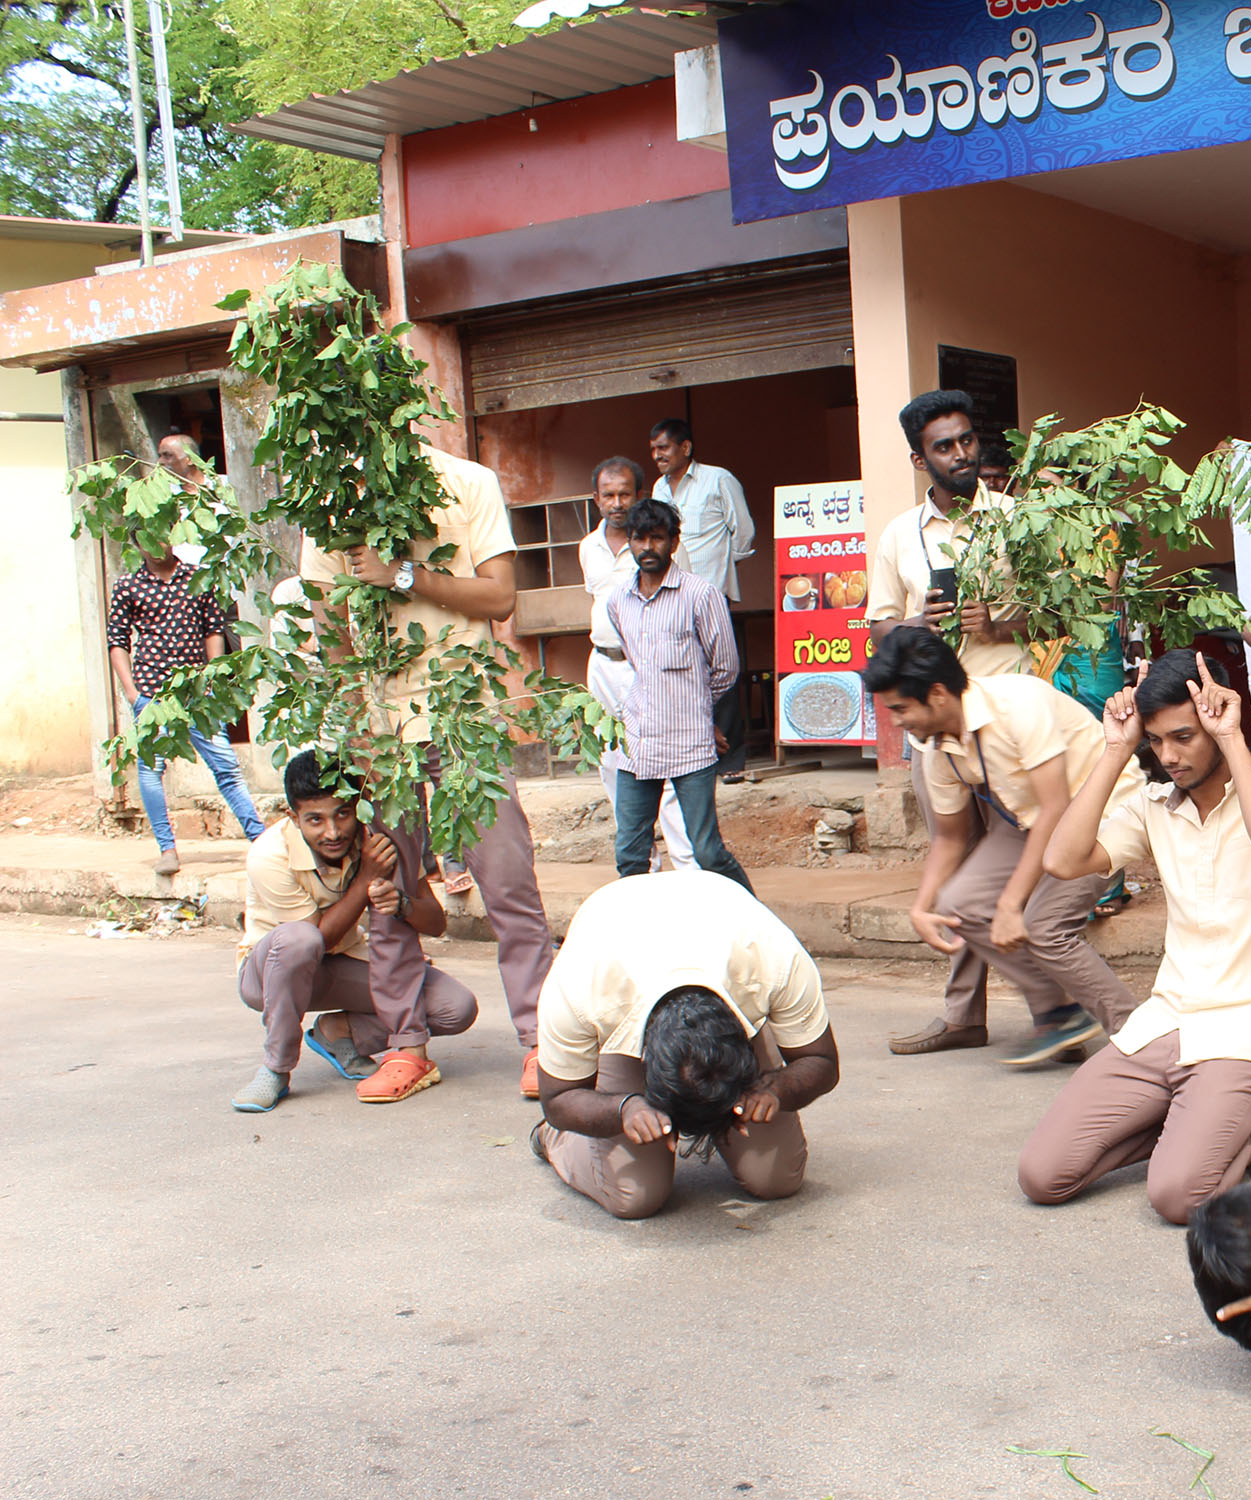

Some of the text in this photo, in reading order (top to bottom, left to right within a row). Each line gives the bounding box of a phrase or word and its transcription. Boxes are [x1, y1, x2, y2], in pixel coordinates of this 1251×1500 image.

[769, 0, 1176, 191] ಪ್ರಯಾಣಿಕರ
[782, 492, 816, 529] ಅನ್ನ
[793, 632, 852, 665] ಗಂಜಿ
